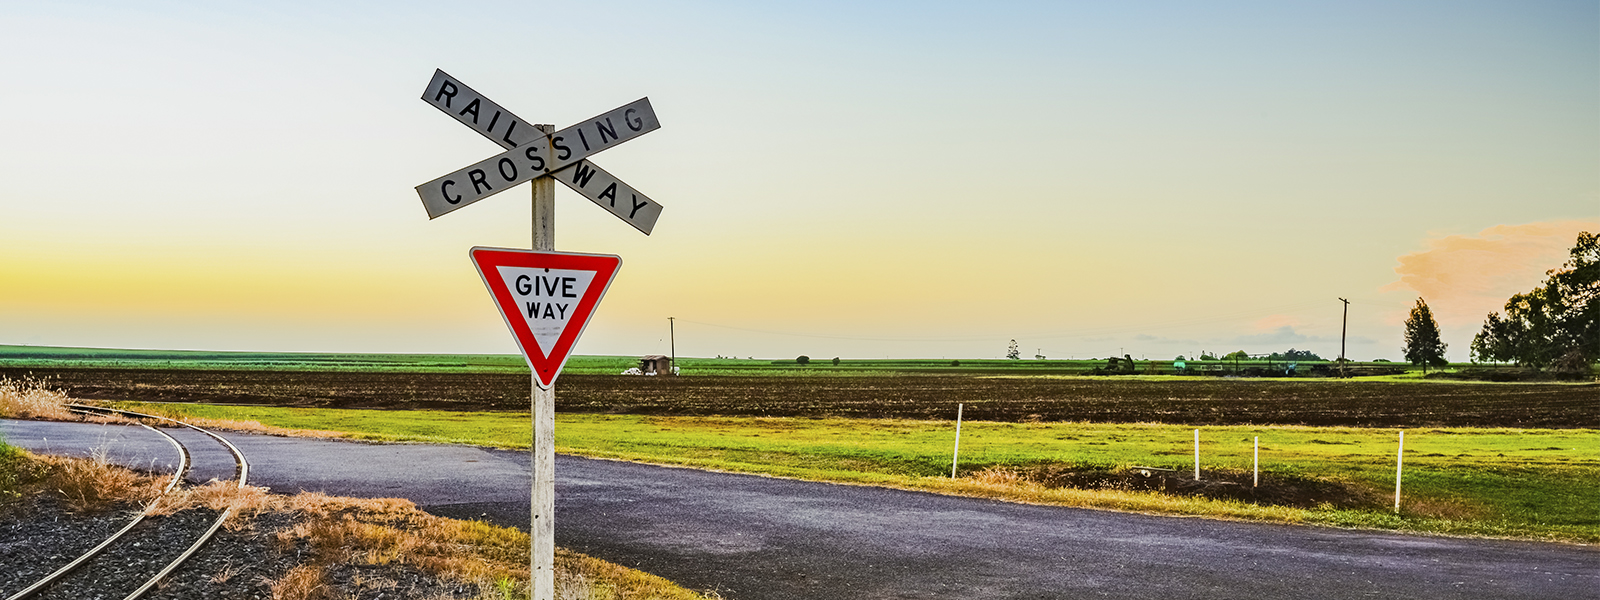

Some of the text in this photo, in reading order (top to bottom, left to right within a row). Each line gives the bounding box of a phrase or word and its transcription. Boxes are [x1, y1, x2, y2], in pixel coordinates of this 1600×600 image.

[435, 79, 648, 219] RAIL WAY
[441, 108, 644, 205] CROSSING
[515, 274, 577, 298] GIVE
[526, 301, 569, 320] WAY
